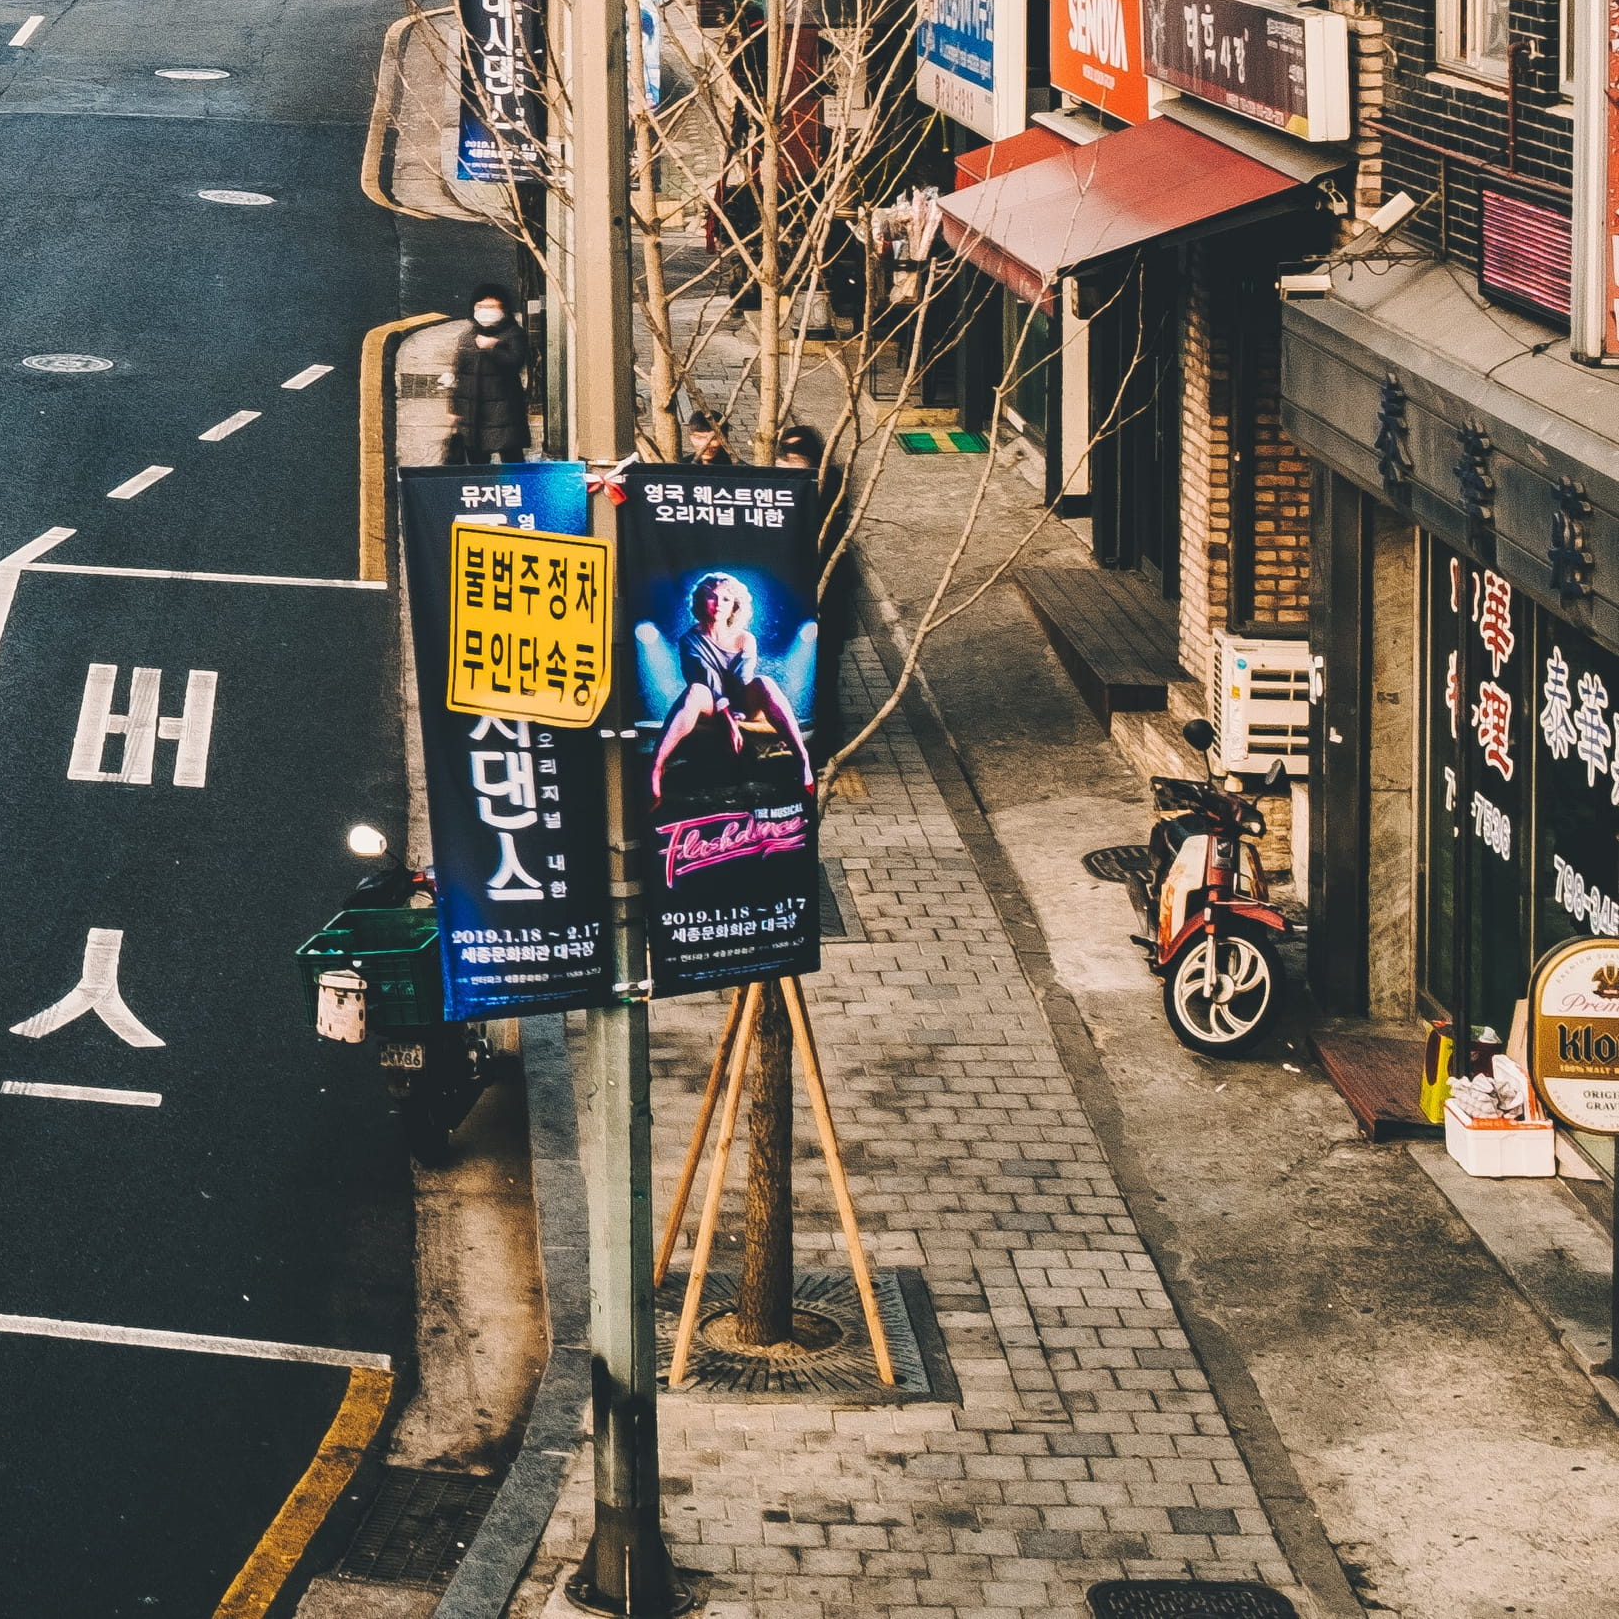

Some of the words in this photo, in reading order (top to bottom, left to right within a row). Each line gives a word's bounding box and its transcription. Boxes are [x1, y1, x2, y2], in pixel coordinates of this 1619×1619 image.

[461, 484, 522, 508] 뮤지컬
[644, 483, 685, 504] 영국
[693, 485, 795, 508] 웨스트엔드
[655, 505, 735, 526] 오리지널
[745, 508, 785, 528] 내한
[464, 546, 597, 624] 불법주정차
[462, 629, 596, 707] 무인단속중
[1540, 645, 1619, 806] 泰華
[536, 732, 562, 829] 오리지널
[770, 802, 804, 819] MUSICAL
[546, 854, 567, 898] 내한
[662, 906, 750, 926] 2019.1.18
[452, 928, 543, 944] 2019.1.18
[567, 922, 600, 940] 2.17
[671, 921, 758, 943] 세종문화회관
[461, 944, 551, 964] 세종문화회관
[553, 940, 595, 960] 대극장
[1556, 1022, 1619, 1065] Klo
[1560, 1065, 1584, 1073] 100%
[1586, 1066, 1610, 1074] MALT
